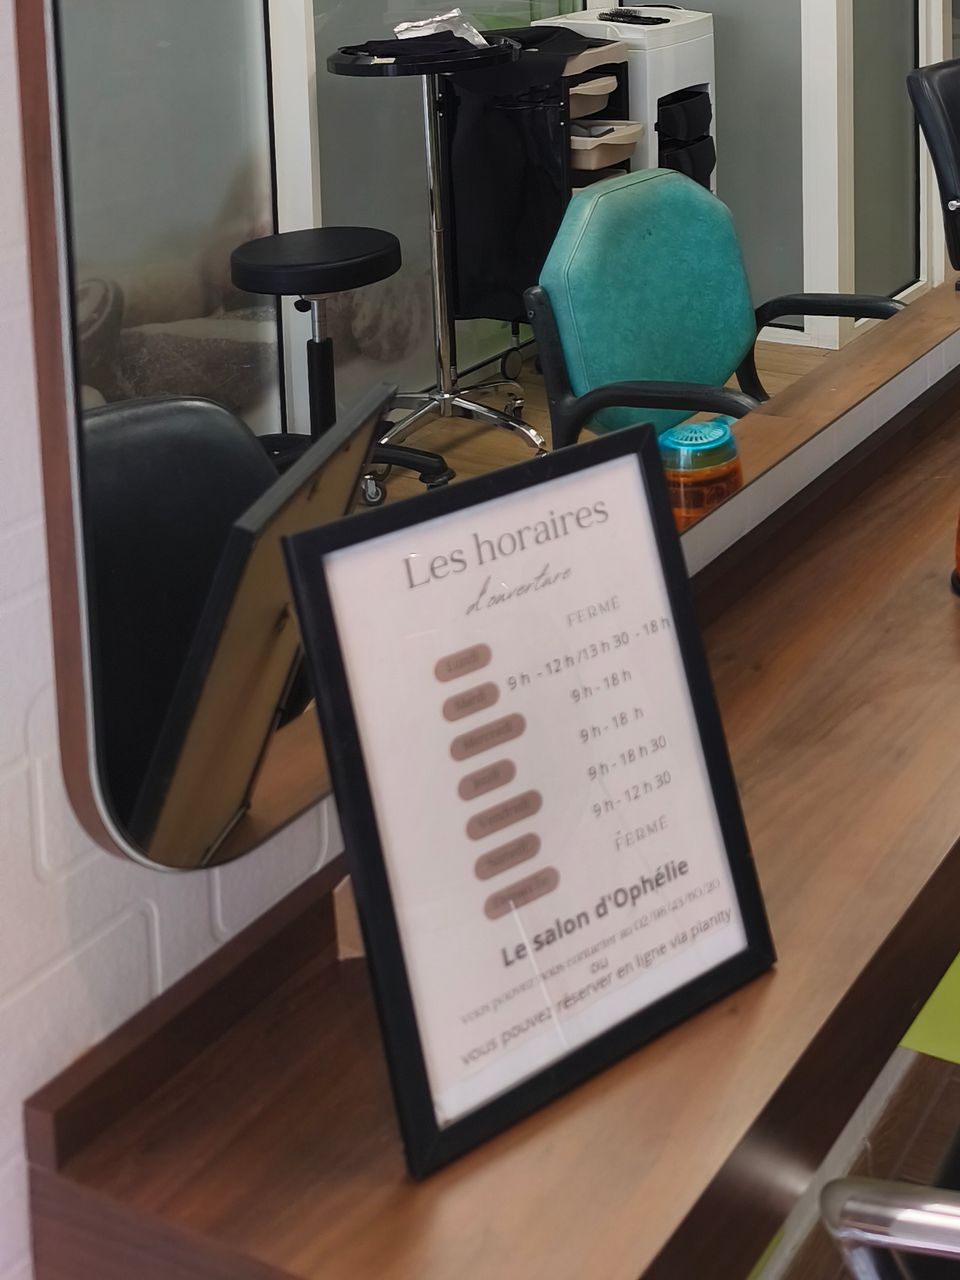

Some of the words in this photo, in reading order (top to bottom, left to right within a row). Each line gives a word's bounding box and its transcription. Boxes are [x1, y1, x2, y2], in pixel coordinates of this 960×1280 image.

[402, 549, 467, 588] Les
[472, 501, 608, 565] horaires
[502, 943, 527, 966] Le
[532, 911, 589, 952] salon
[595, 860, 688, 918] d'Ophélie
[461, 1038, 497, 1064] vous
[501, 1006, 552, 1045] pouvez
[556, 973, 611, 1011] réserver
[616, 963, 632, 978] en
[635, 943, 666, 968] ligne
[670, 932, 687, 947] via
[590, 959, 608, 973] ou
